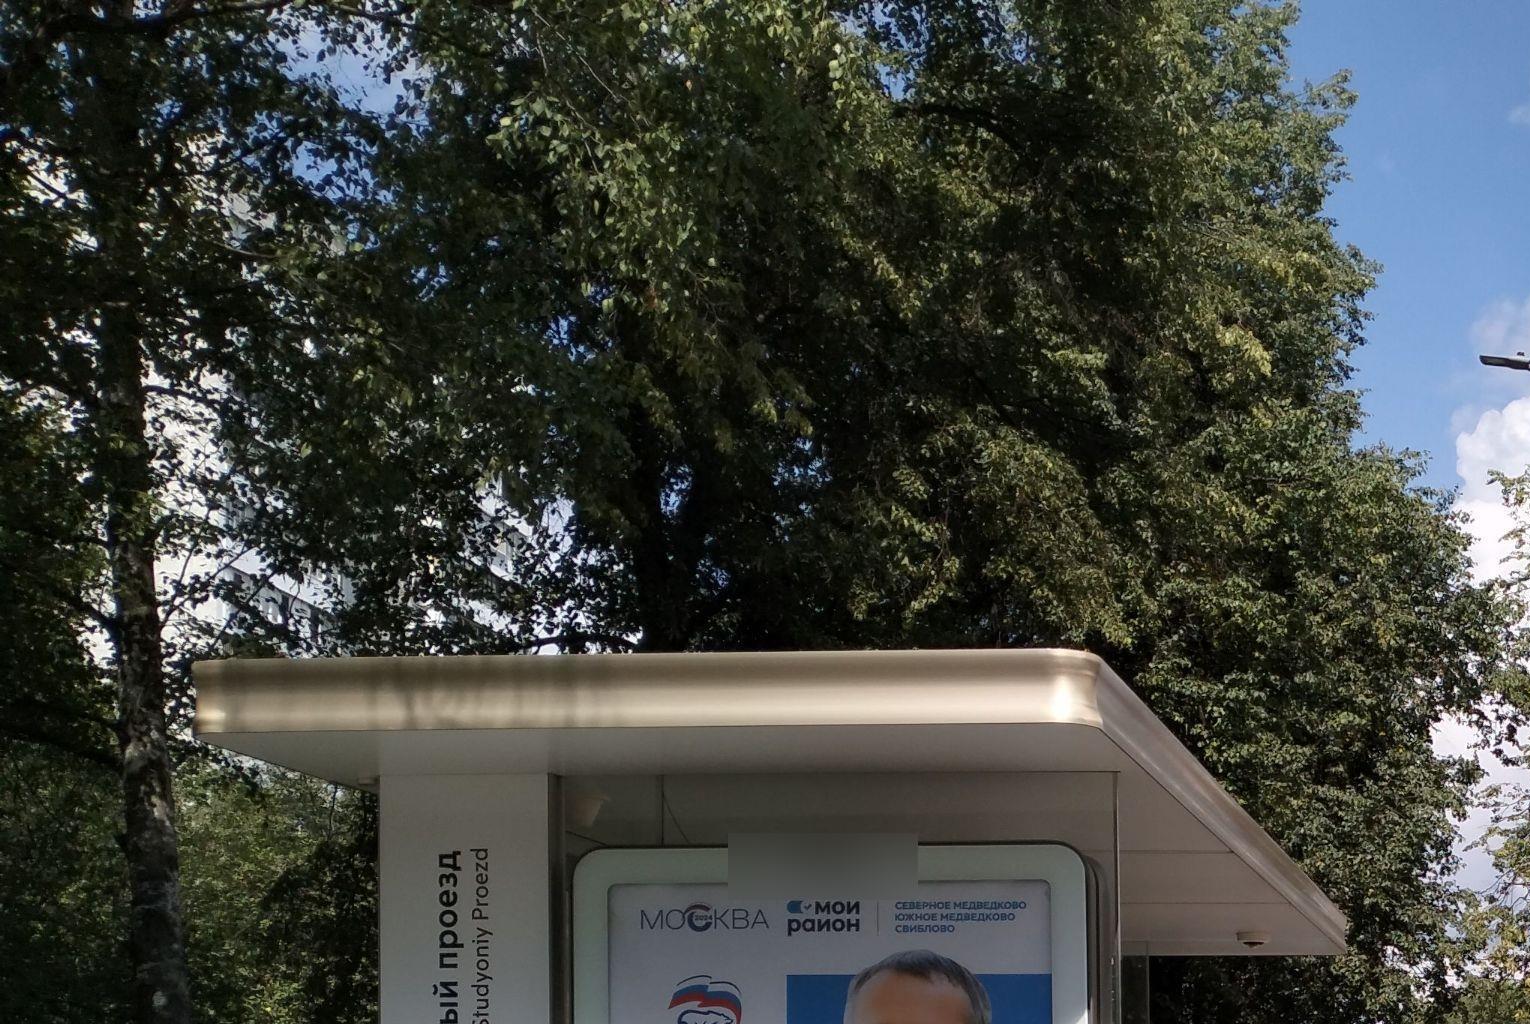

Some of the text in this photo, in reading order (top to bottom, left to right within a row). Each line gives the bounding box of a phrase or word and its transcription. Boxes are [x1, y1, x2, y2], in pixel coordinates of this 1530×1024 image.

[470, 848, 489, 921] Proezd
[439, 850, 465, 969] проезд
[895, 901, 1027, 911] СЕВЕРНОЕ МЕДВЕДКОВО
[895, 912, 1016, 922] ЮЖНОЕ МЕДВЕДКОВО
[895, 924, 955, 933] СВИБЛОВО
